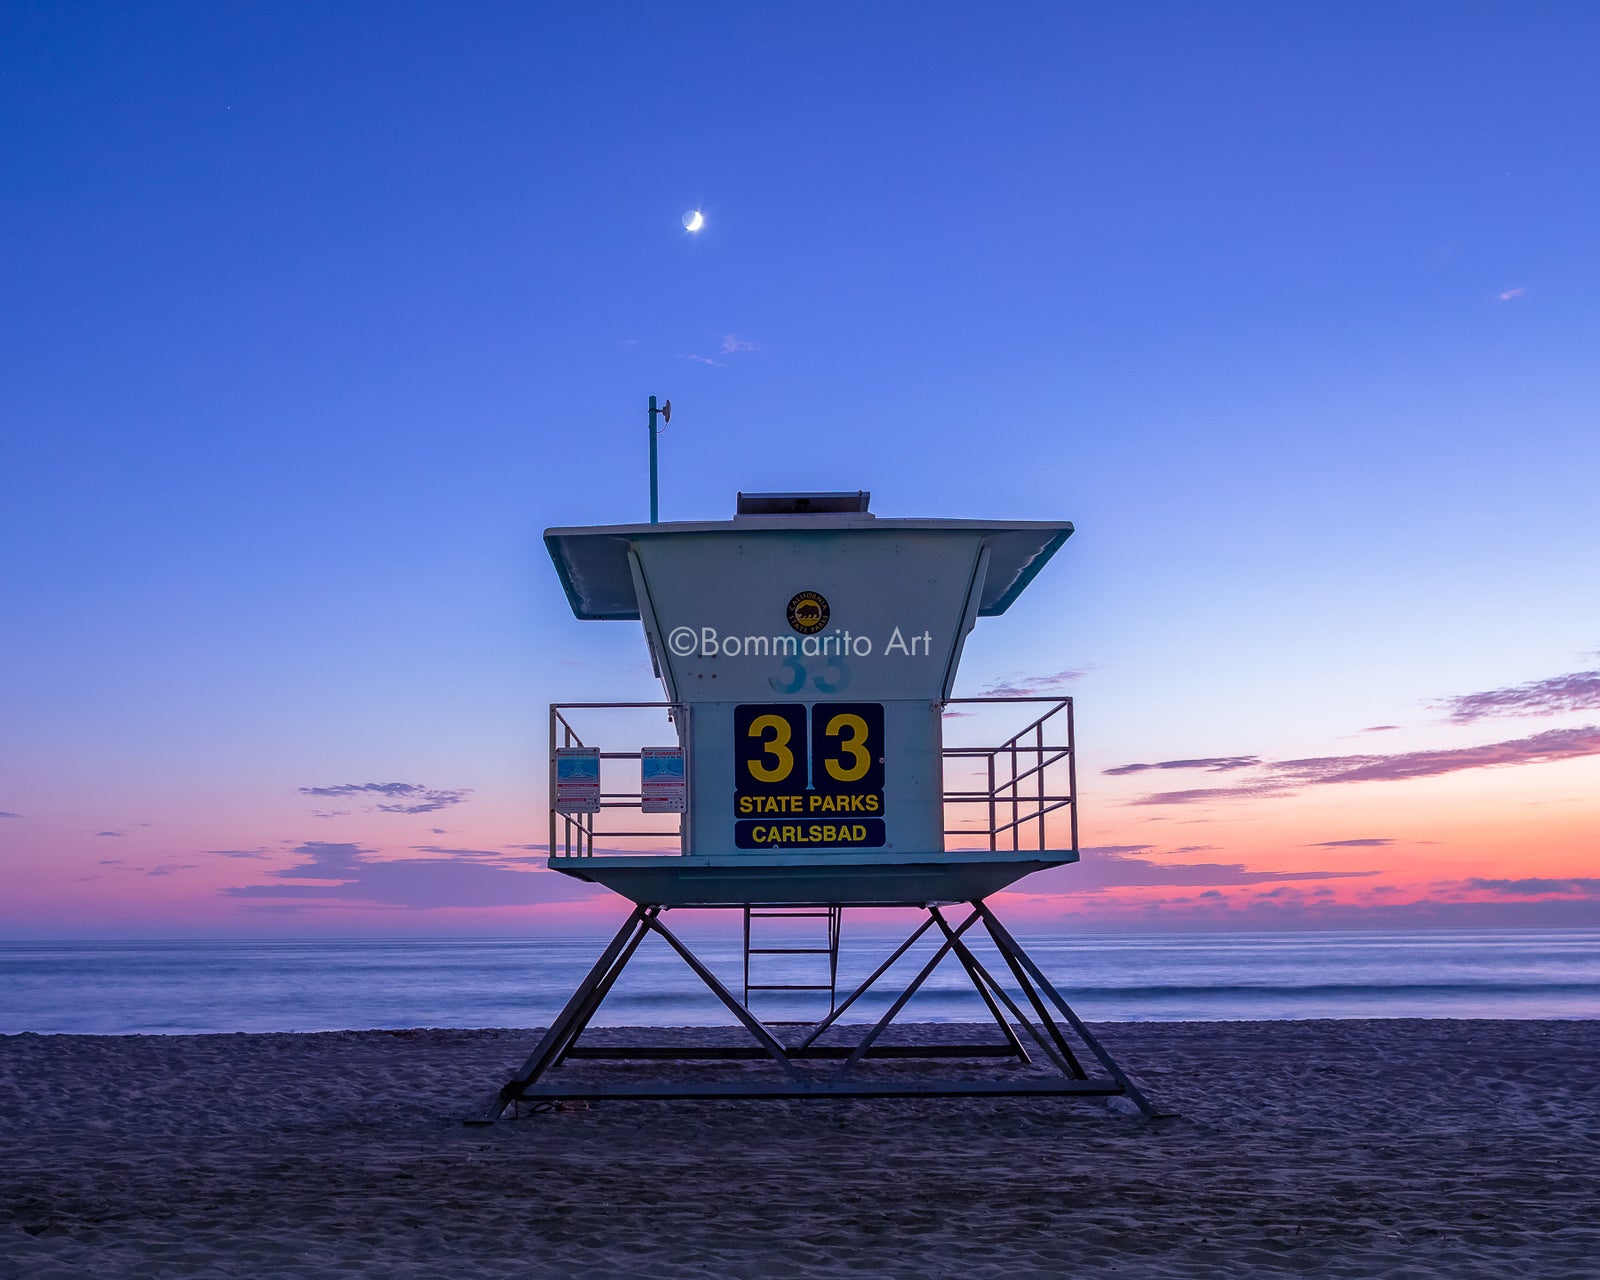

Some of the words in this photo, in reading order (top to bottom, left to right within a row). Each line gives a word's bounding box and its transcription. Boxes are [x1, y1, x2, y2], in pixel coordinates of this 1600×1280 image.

[789, 593, 828, 611] CALIFORNIA
[789, 615, 808, 633] STATE
[811, 615, 829, 633] PARKS
[739, 795, 803, 813] STATE
[809, 794, 879, 812] PARKS
[752, 825, 867, 843] CARLSBAD
